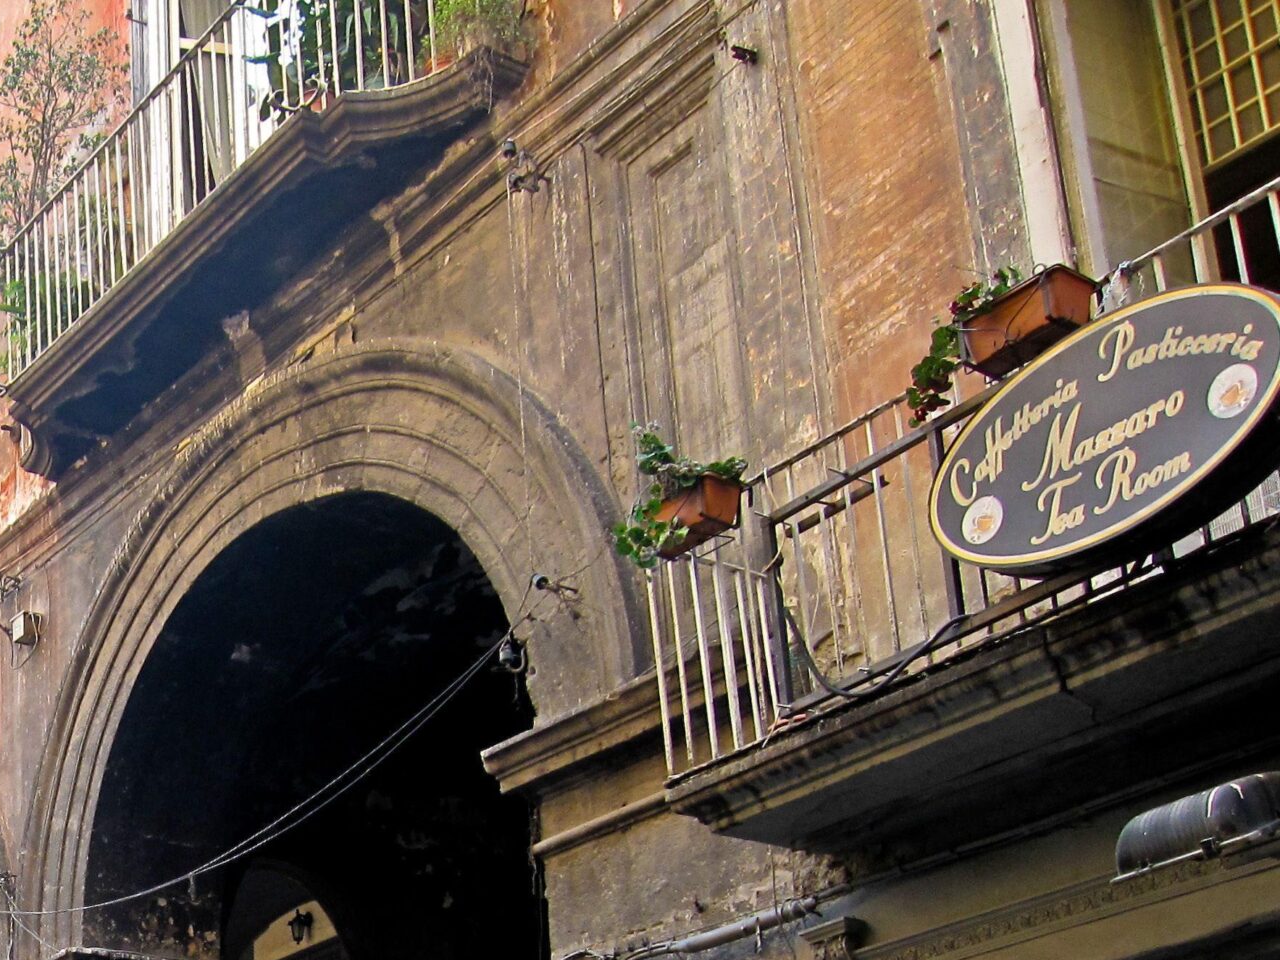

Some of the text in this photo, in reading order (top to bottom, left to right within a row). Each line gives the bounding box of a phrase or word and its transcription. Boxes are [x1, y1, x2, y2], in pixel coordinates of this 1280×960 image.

[1097, 320, 1264, 382] Pasticceria
[950, 378, 1079, 507] Caffetteria
[1021, 390, 1184, 491] Mazzaro
[1030, 446, 1192, 545] Tea Room
